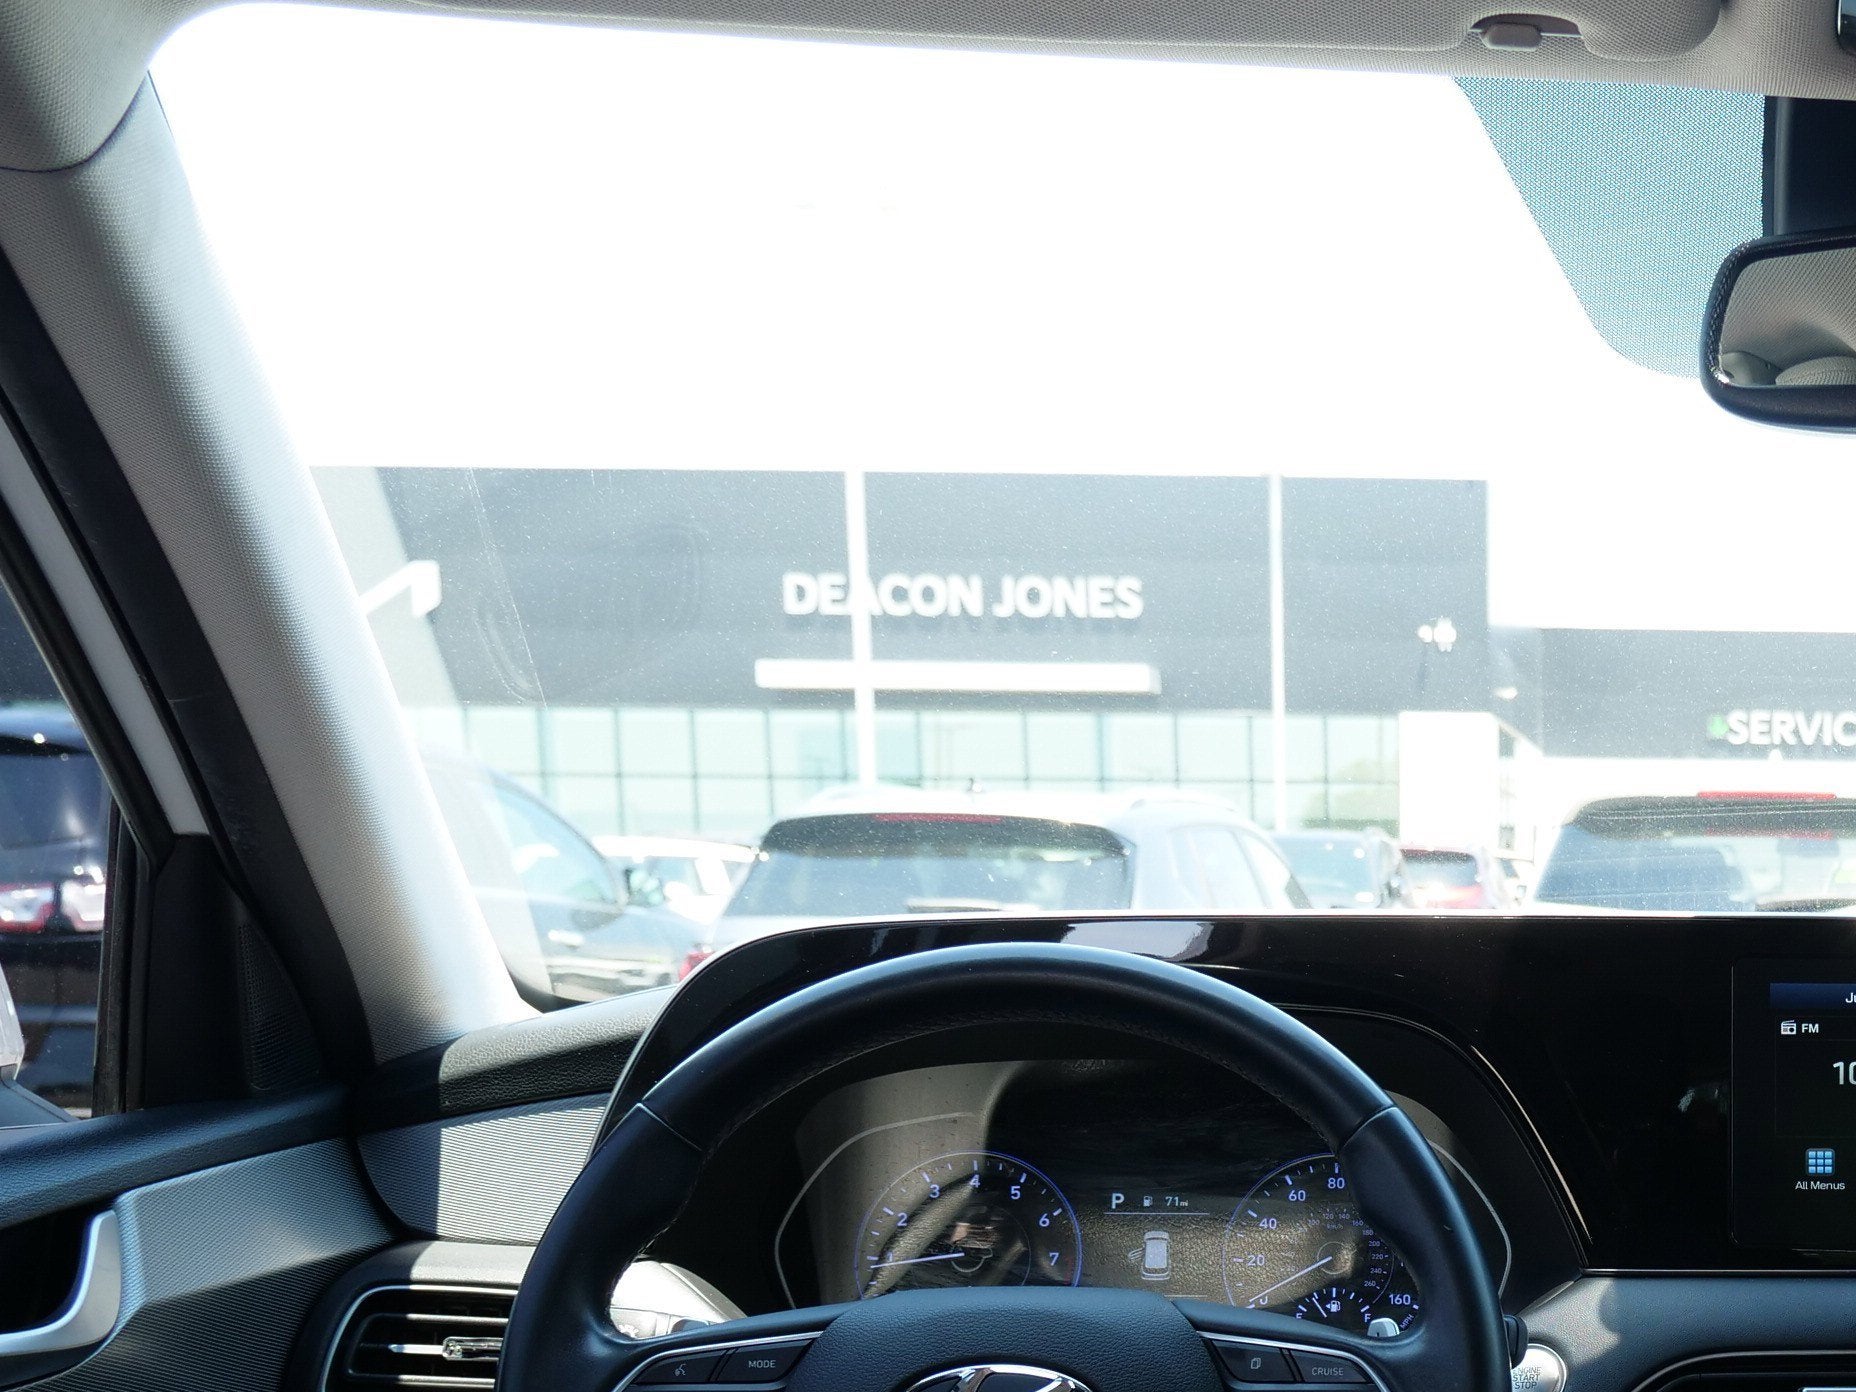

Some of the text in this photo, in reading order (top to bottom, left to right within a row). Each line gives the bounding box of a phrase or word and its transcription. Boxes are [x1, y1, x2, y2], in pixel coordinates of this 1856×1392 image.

[782, 573, 1144, 620] DEACON JONES
[1801, 1023, 1820, 1034] FM
[970, 1175, 980, 1188] 4
[1327, 1178, 1345, 1189] 80
[1795, 1181, 1845, 1190] All Menus
[930, 1184, 940, 1198] 3
[1010, 1186, 1021, 1200] 5
[1288, 1190, 1306, 1201] 60
[1111, 1192, 1125, 1209] P
[897, 1213, 908, 1227] 2
[1039, 1213, 1049, 1227] 6
[1259, 1218, 1277, 1229] 40
[1050, 1252, 1059, 1266] 7
[1247, 1255, 1265, 1266] 20
[1389, 1294, 1411, 1305] 160
[1364, 1313, 1371, 1322] F
[1400, 1314, 1414, 1330] MPH
[748, 1359, 776, 1369] MODE
[1311, 1367, 1344, 1376] CRUISE
